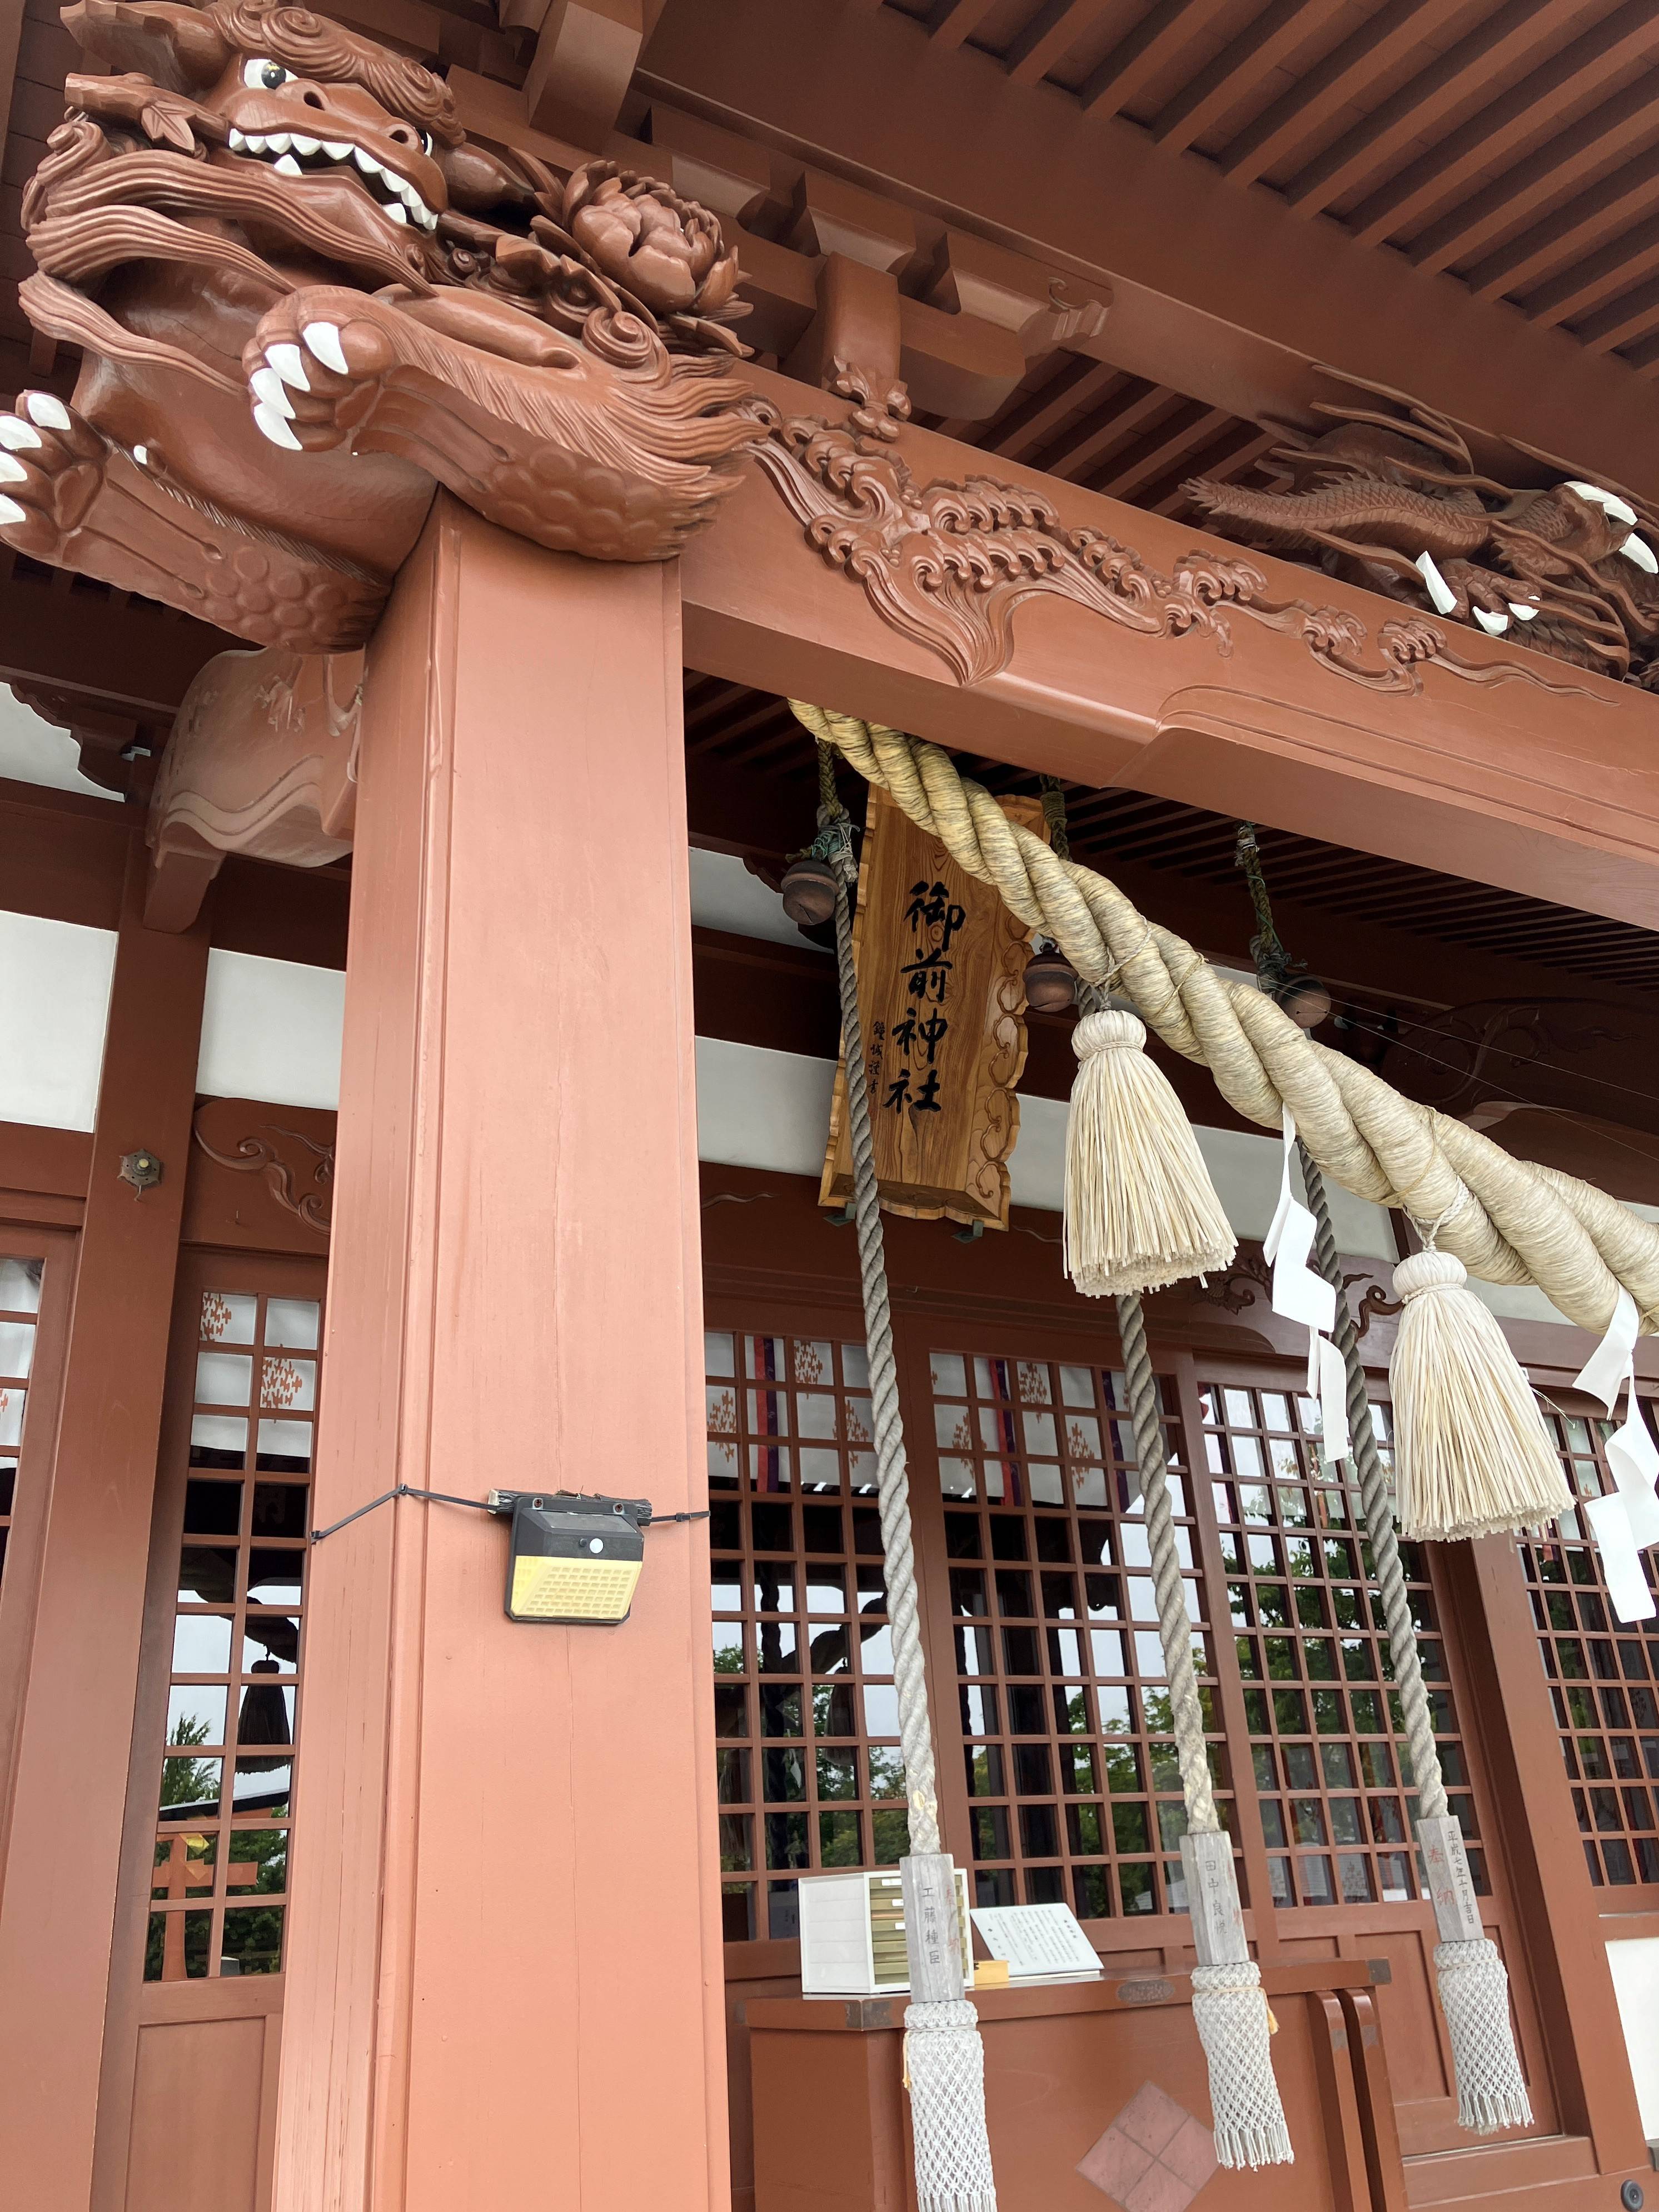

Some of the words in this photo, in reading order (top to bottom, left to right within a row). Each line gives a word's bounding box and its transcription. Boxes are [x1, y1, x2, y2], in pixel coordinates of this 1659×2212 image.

[882, 880, 966, 1115] 御前神社
[1205, 1860, 1227, 1934] 田中良悦
[1428, 1845, 1456, 1906] 奉納
[922, 1888, 940, 1964] 工藤種臣
